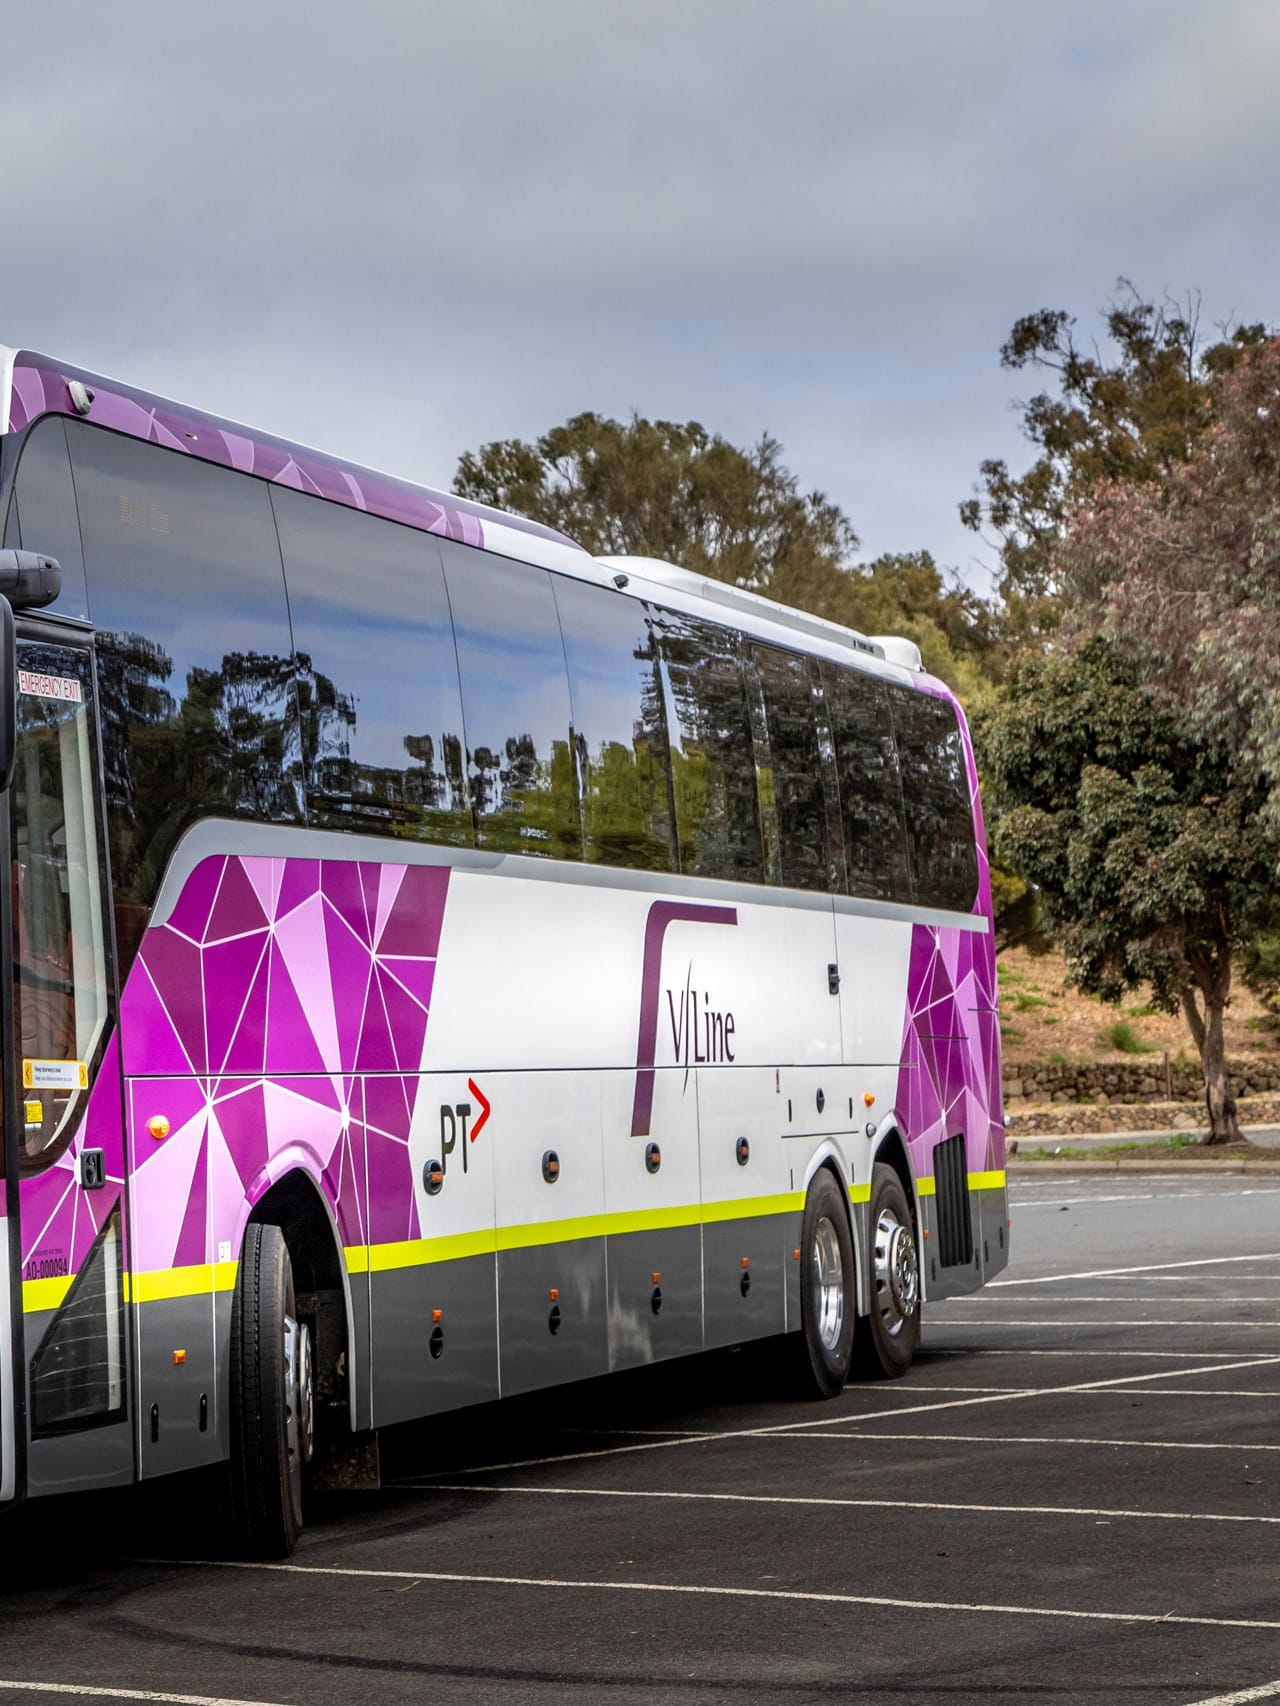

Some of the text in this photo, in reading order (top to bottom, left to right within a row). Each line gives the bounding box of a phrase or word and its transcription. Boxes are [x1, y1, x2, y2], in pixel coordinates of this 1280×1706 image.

[20, 672, 79, 699] EMERGENCY EXIT
[440, 1103, 471, 1176] PT
